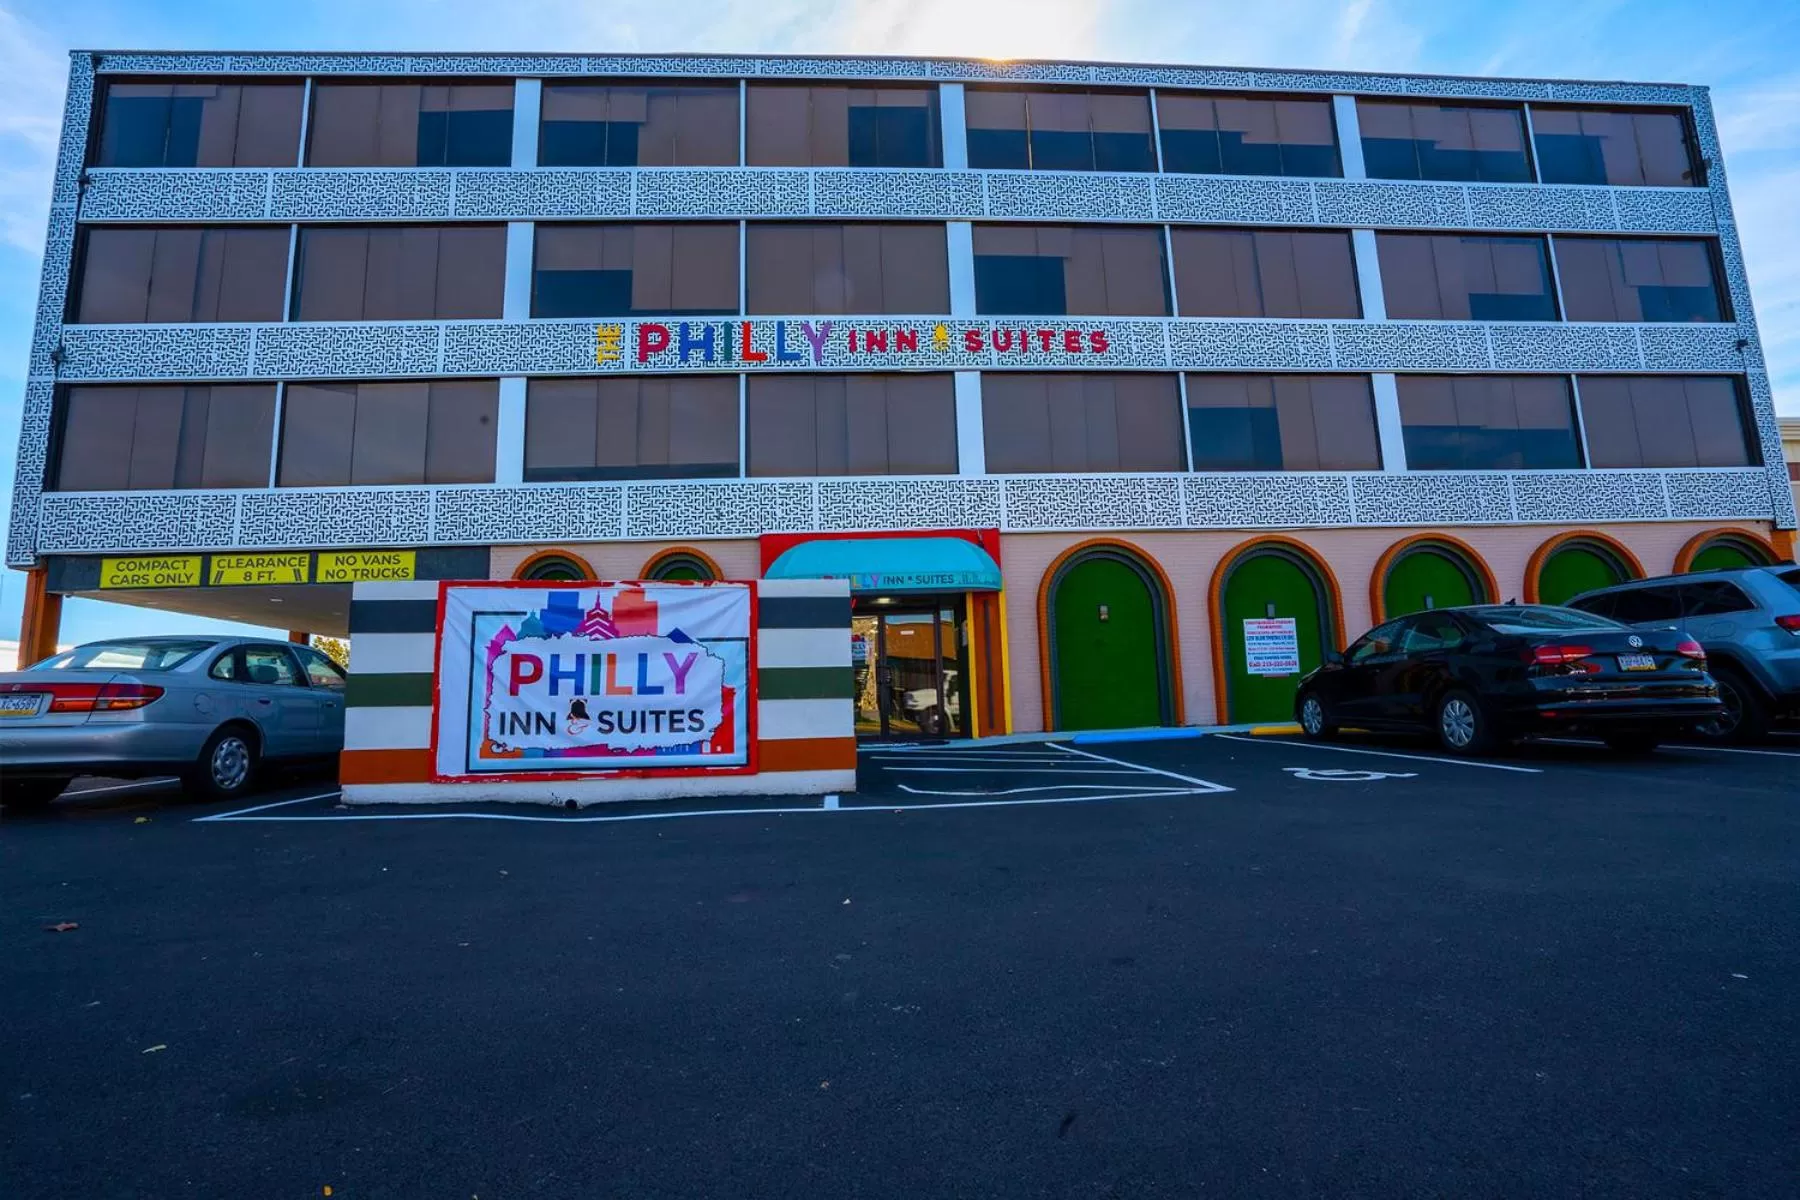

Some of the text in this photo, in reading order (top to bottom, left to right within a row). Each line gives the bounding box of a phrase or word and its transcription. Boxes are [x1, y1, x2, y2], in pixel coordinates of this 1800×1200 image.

[596, 320, 1110, 365] THE PHILLY INN SUITES
[116, 559, 189, 572] COMPACT
[216, 555, 307, 569] CLEARANCE
[335, 553, 401, 566] NO VANS
[109, 572, 194, 585] CARS ONLY
[242, 570, 276, 582] 8 FT.
[325, 567, 410, 580] NO TRUCKS
[883, 575, 904, 585] INN
[915, 573, 954, 585] SUITES
[509, 652, 699, 697] PHILLY
[499, 711, 556, 736] INN
[597, 708, 705, 735] SUITES
